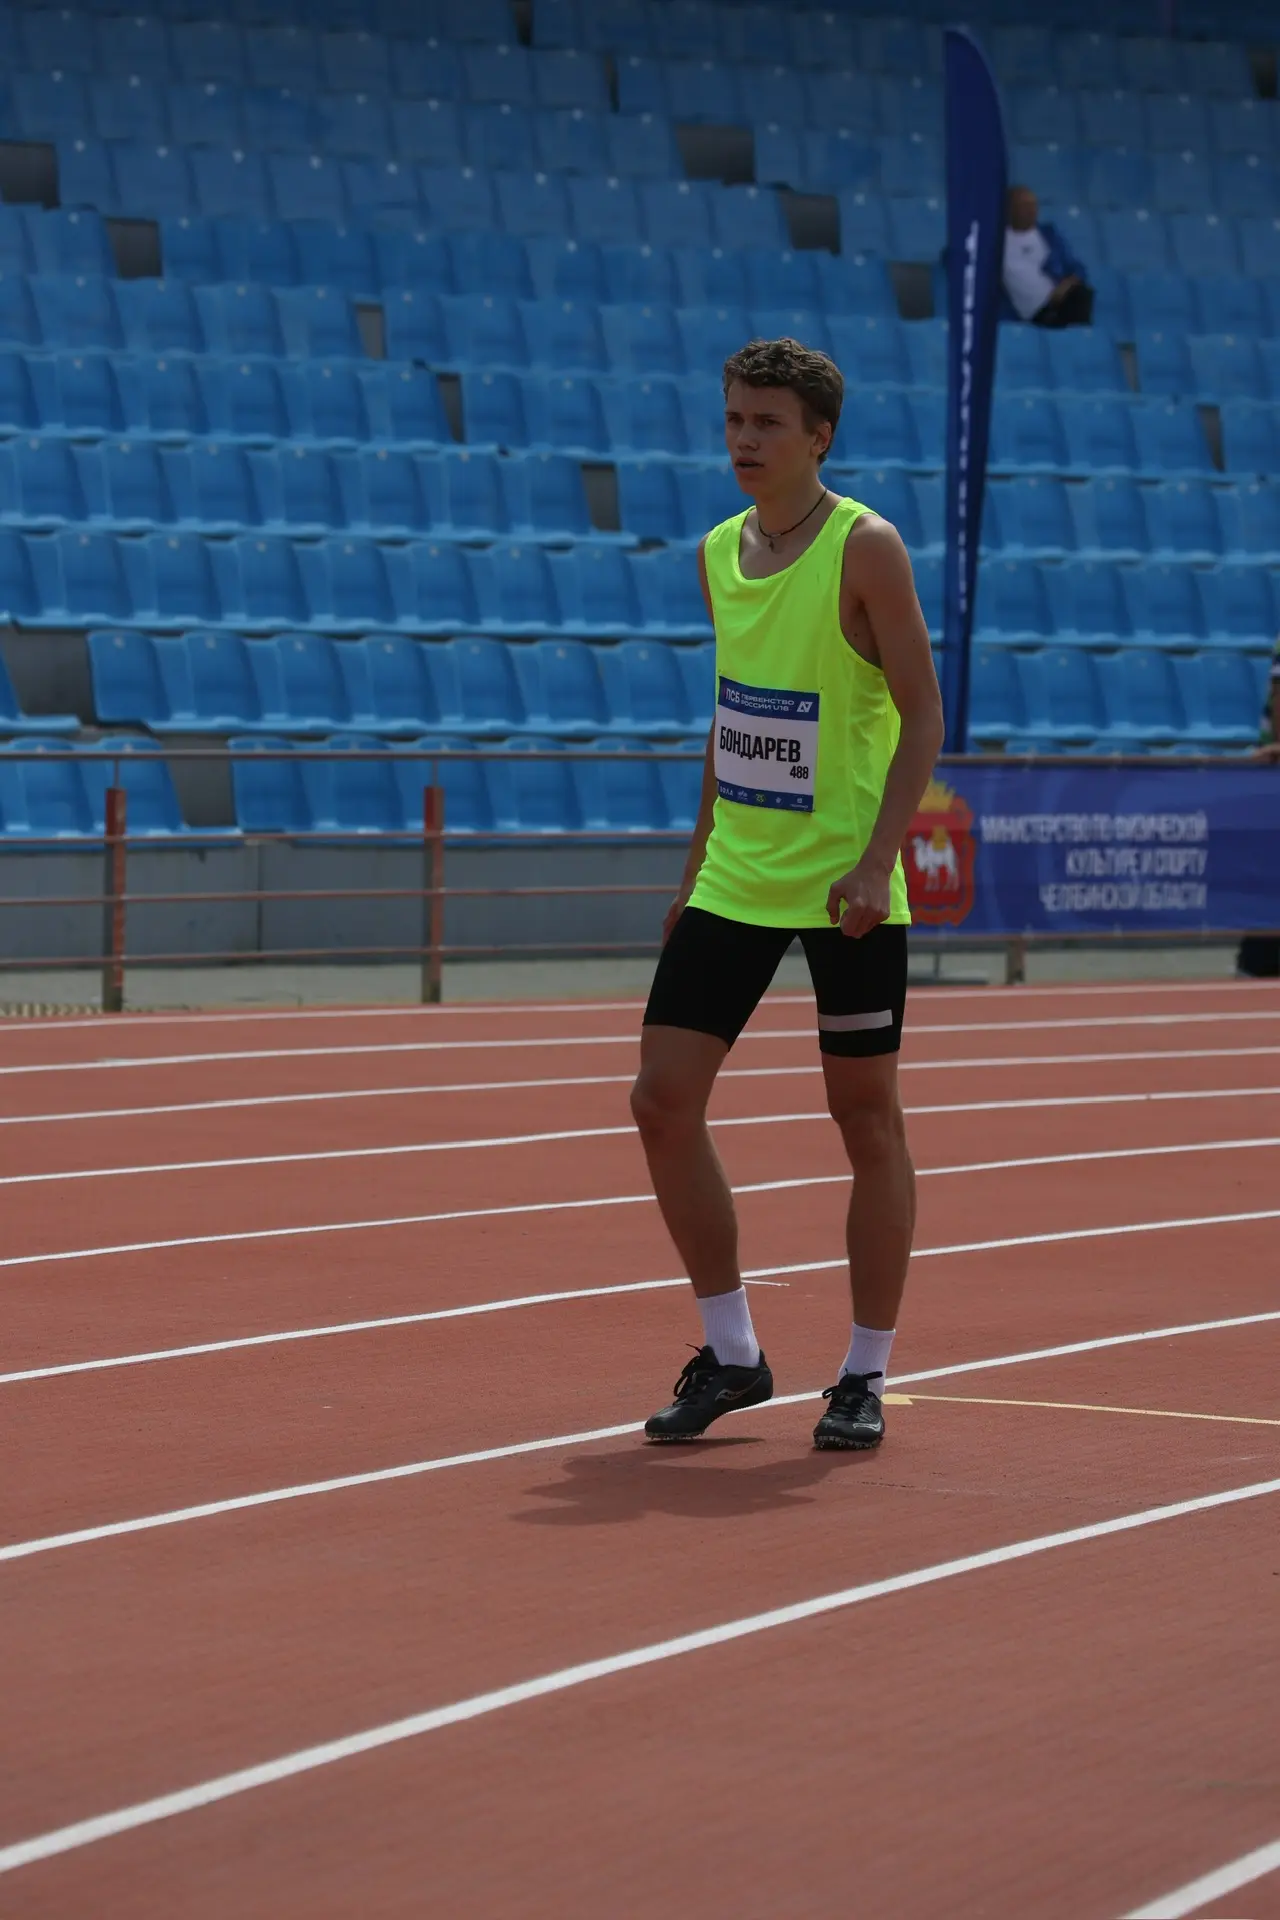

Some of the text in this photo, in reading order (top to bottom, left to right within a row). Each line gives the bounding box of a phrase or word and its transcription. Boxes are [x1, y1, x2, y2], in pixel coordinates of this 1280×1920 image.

[726, 687, 740, 703] ПСБ
[741, 693, 795, 706] ПЕРВЕНСТВО
[741, 700, 771, 710] РОССИИ
[720, 726, 801, 763] БОНДАРЕВ
[790, 766, 809, 779] 488
